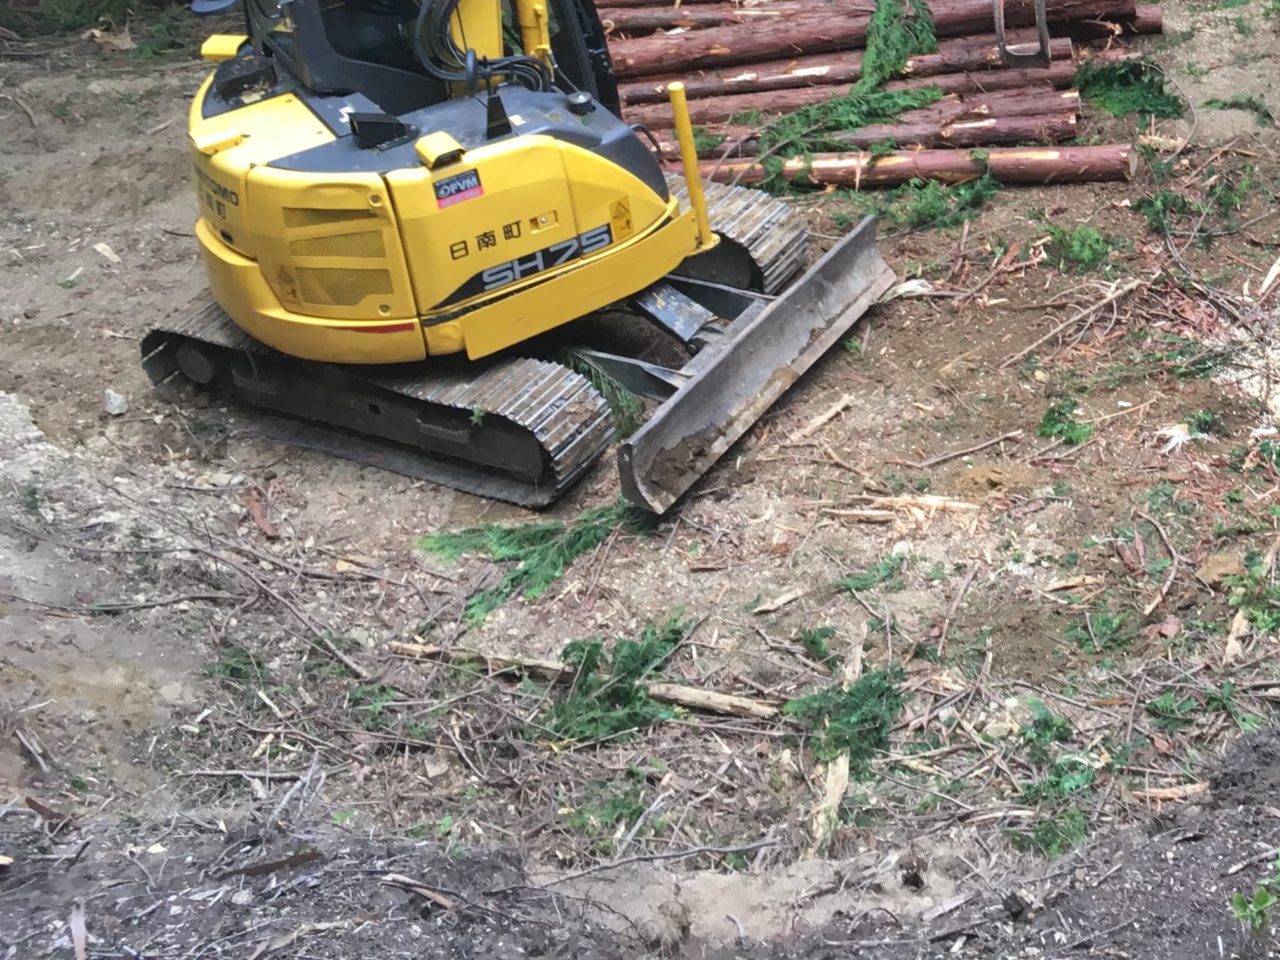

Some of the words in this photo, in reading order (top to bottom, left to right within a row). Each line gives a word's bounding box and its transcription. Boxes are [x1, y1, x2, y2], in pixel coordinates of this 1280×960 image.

[449, 220, 522, 260] 日南町
[482, 224, 610, 290] SH75
